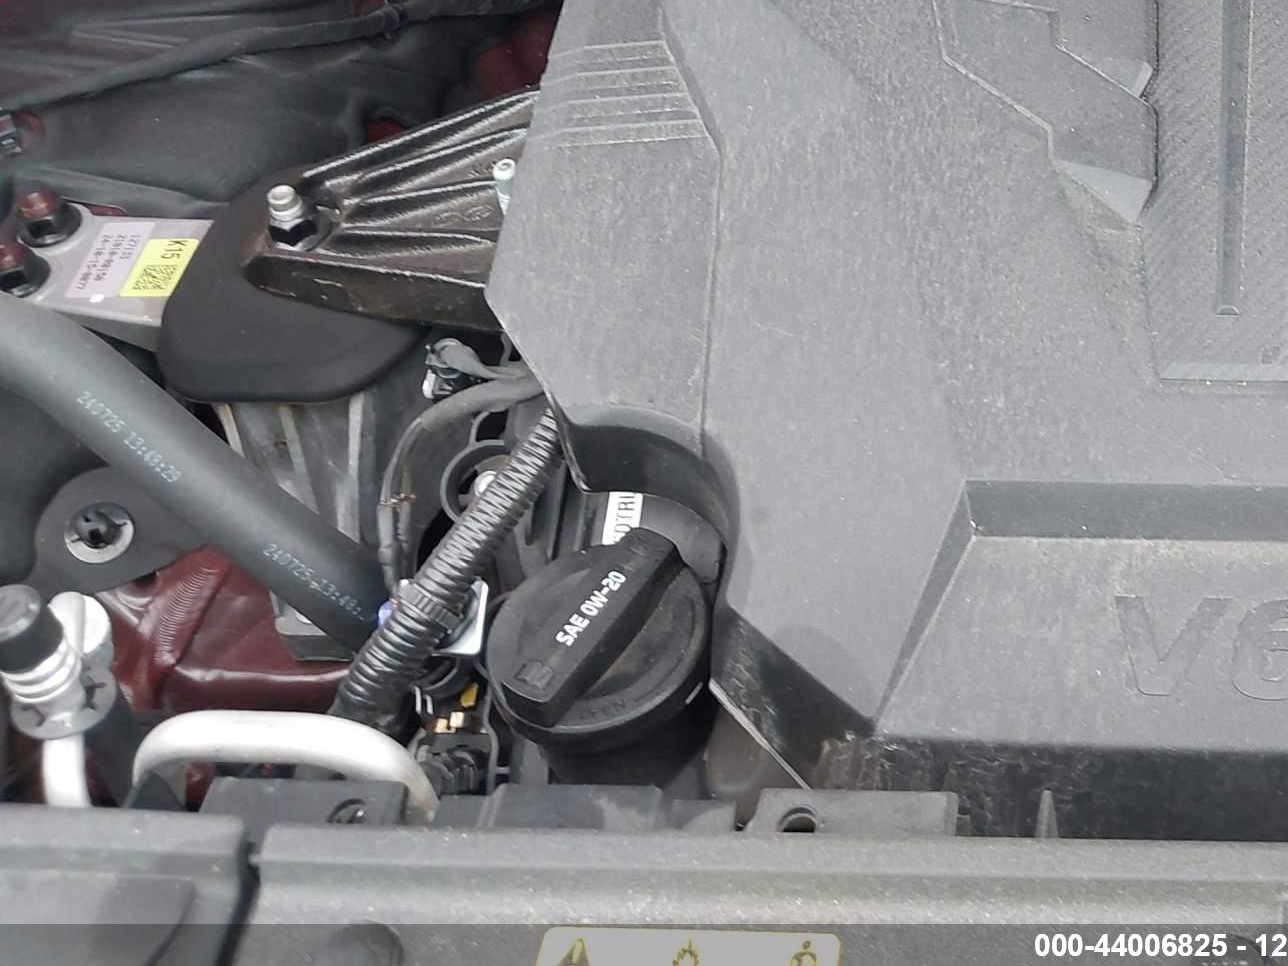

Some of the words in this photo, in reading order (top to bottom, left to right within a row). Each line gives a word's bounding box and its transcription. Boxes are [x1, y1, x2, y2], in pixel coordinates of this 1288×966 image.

[160, 240, 190, 260] K15
[76, 390, 126, 434] 240725
[262, 543, 314, 583] 240725
[555, 613, 590, 647] SAE
[580, 570, 627, 618] 0W-20
